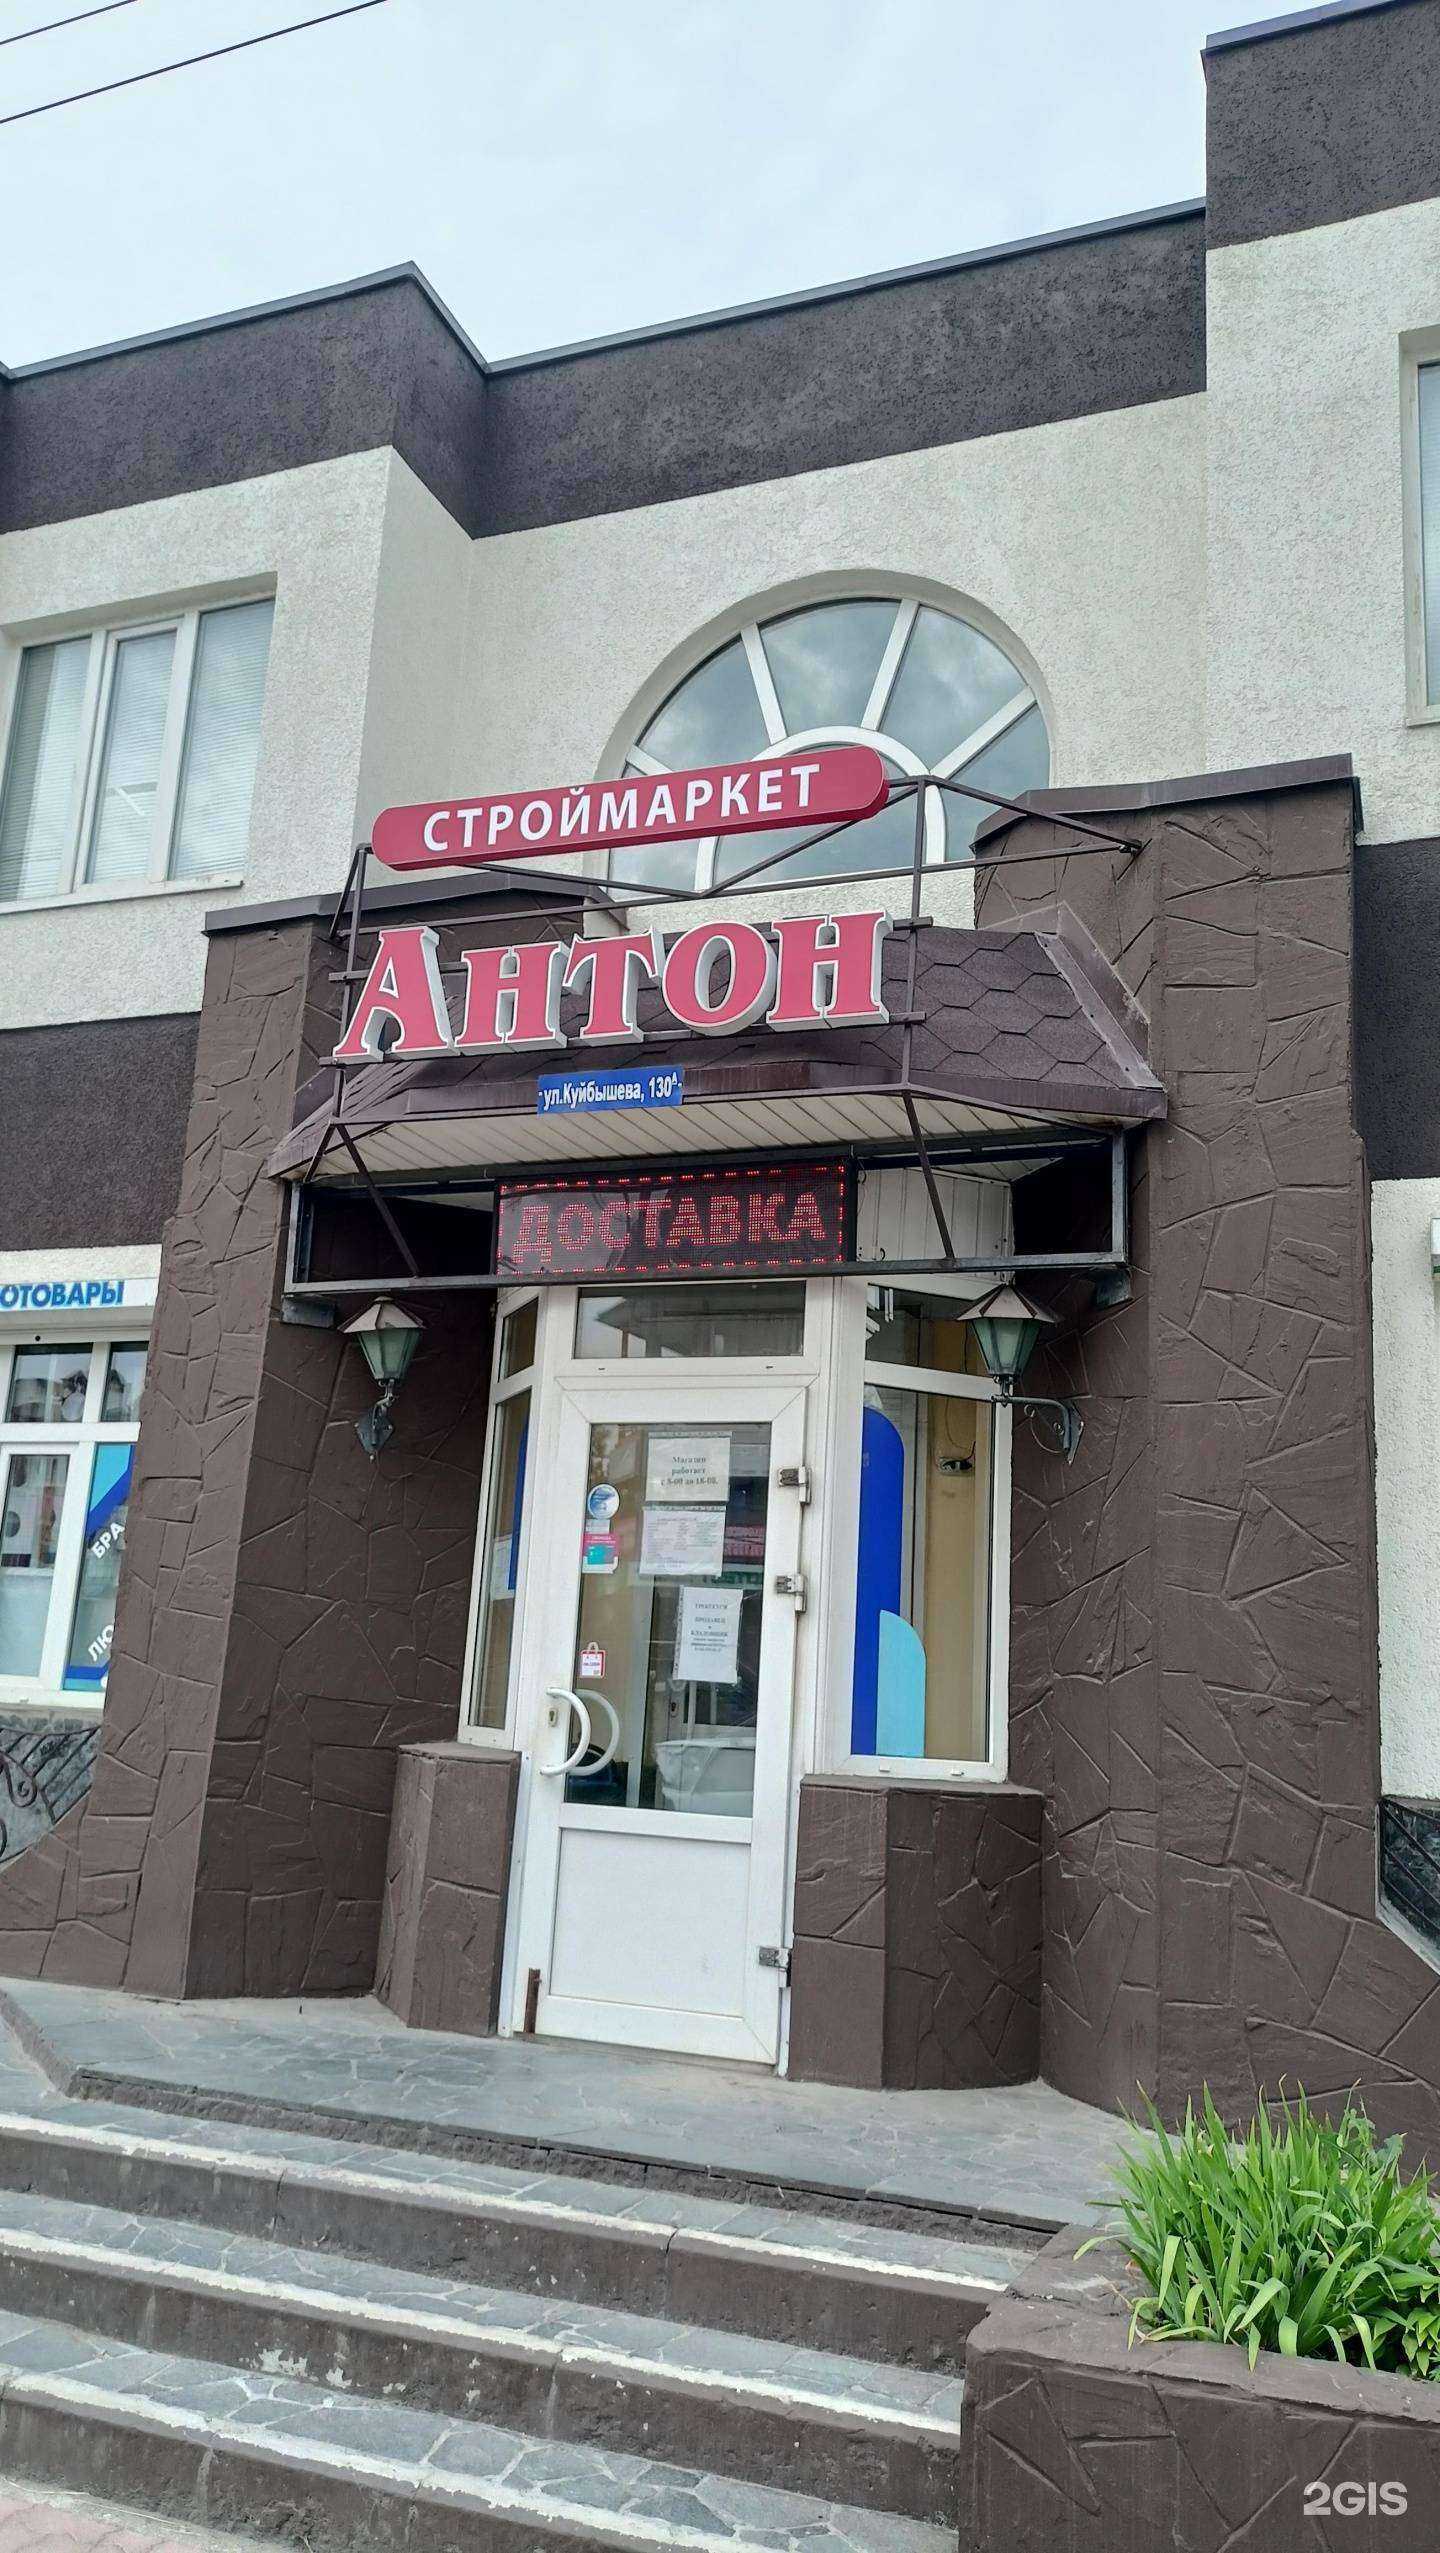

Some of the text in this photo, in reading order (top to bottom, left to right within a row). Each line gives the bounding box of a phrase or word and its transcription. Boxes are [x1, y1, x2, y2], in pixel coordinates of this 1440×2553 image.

[423, 762, 821, 852] СТРОЙМАРКЕТ
[512, 1192, 827, 1264] ДОСТАВКА
[91, 1521, 126, 1559] БРА
